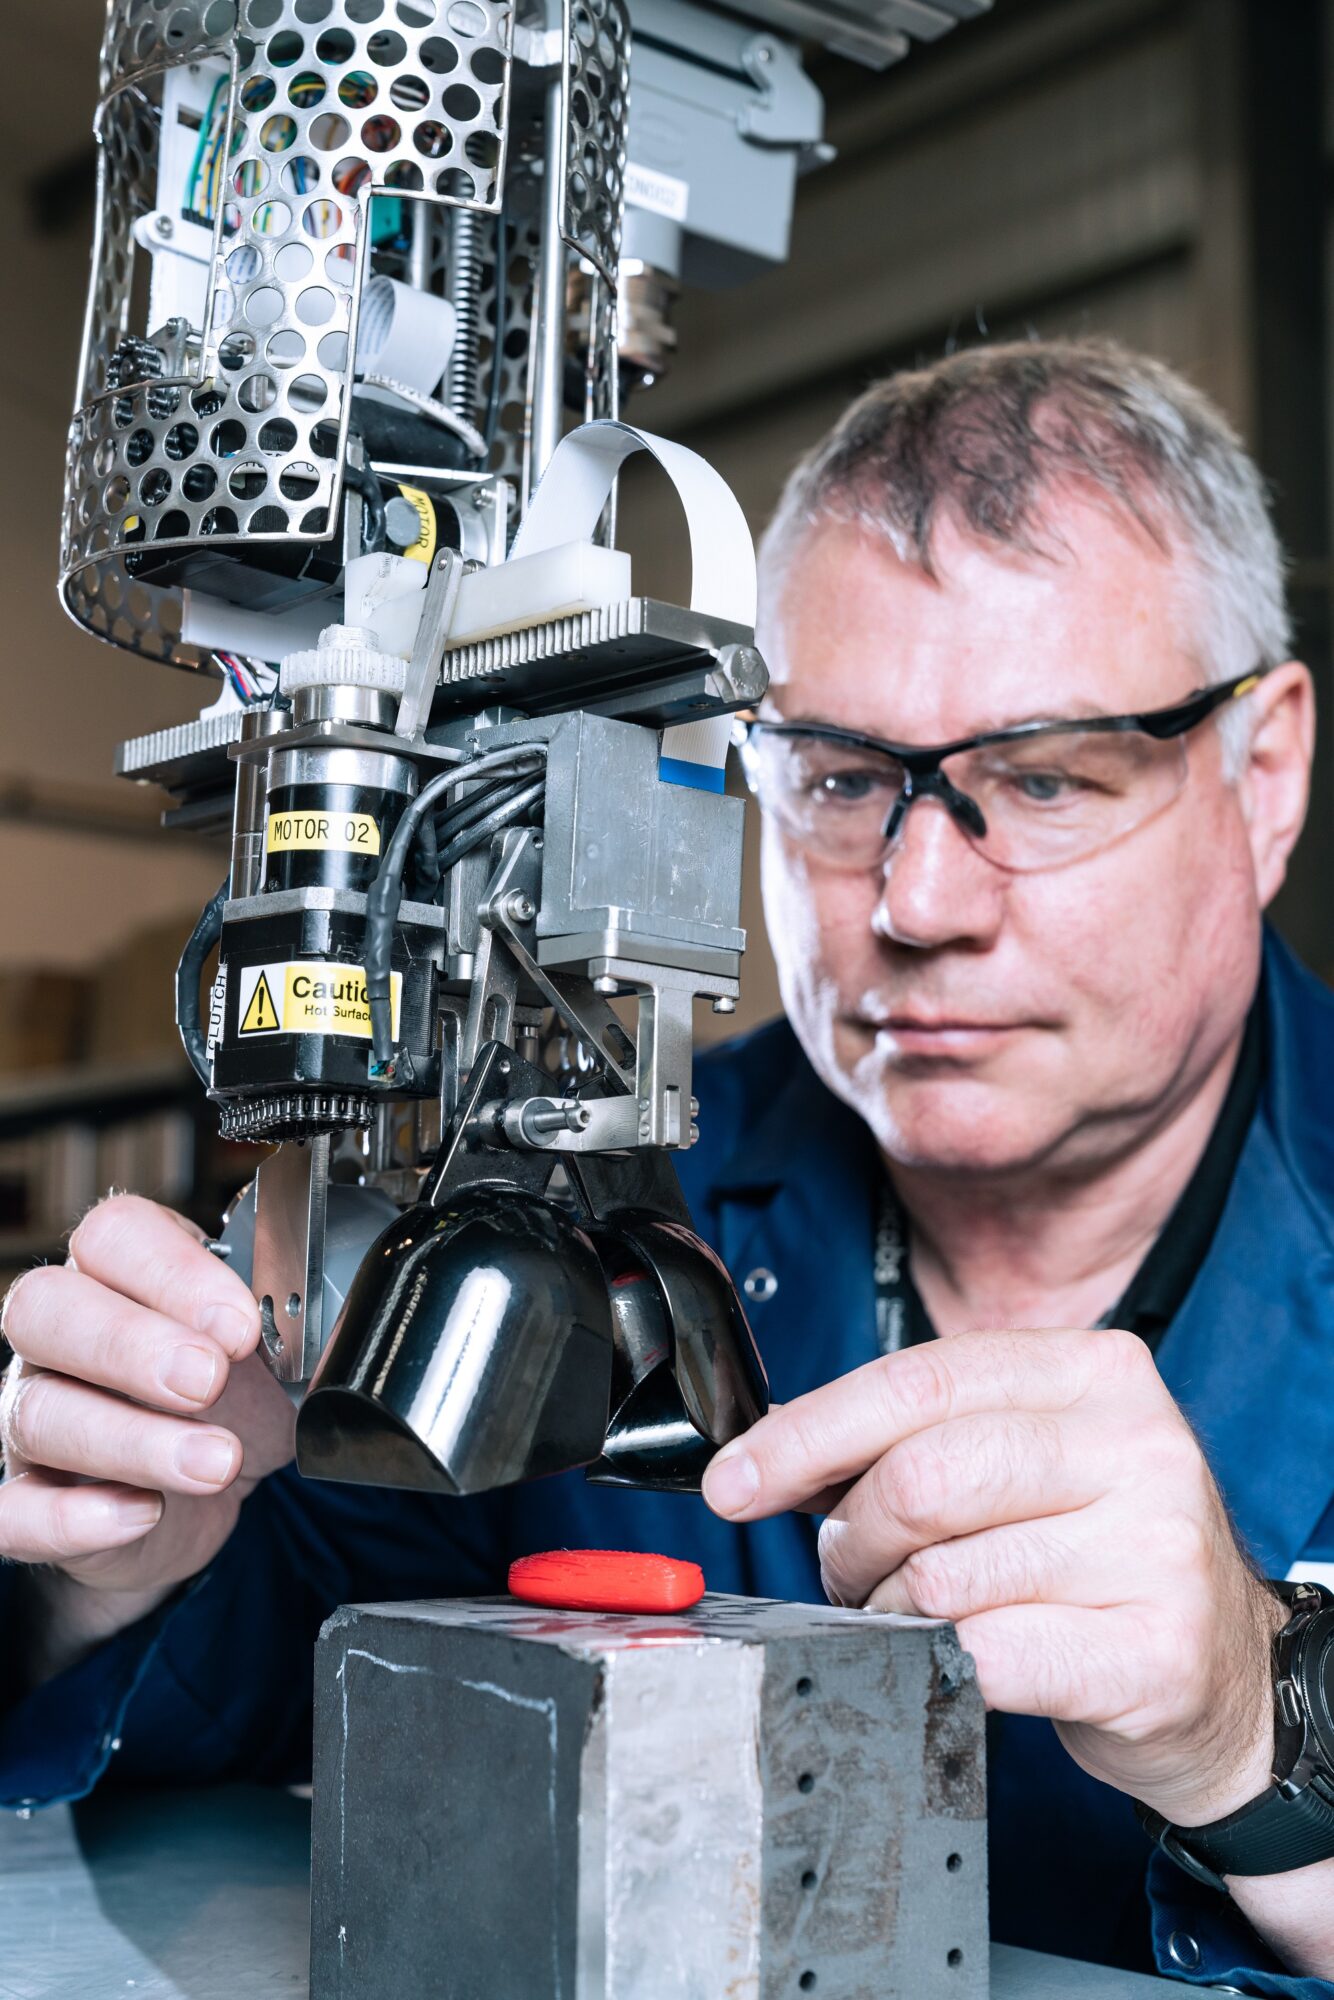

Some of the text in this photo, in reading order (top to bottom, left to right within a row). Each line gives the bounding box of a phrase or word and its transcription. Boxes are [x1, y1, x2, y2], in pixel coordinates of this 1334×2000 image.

[274, 818, 370, 844] MOTOR 02
[292, 975, 370, 1004] Cautio
[208, 975, 226, 1050] CLUTCH
[304, 1004, 372, 1022] Hot Surfac
